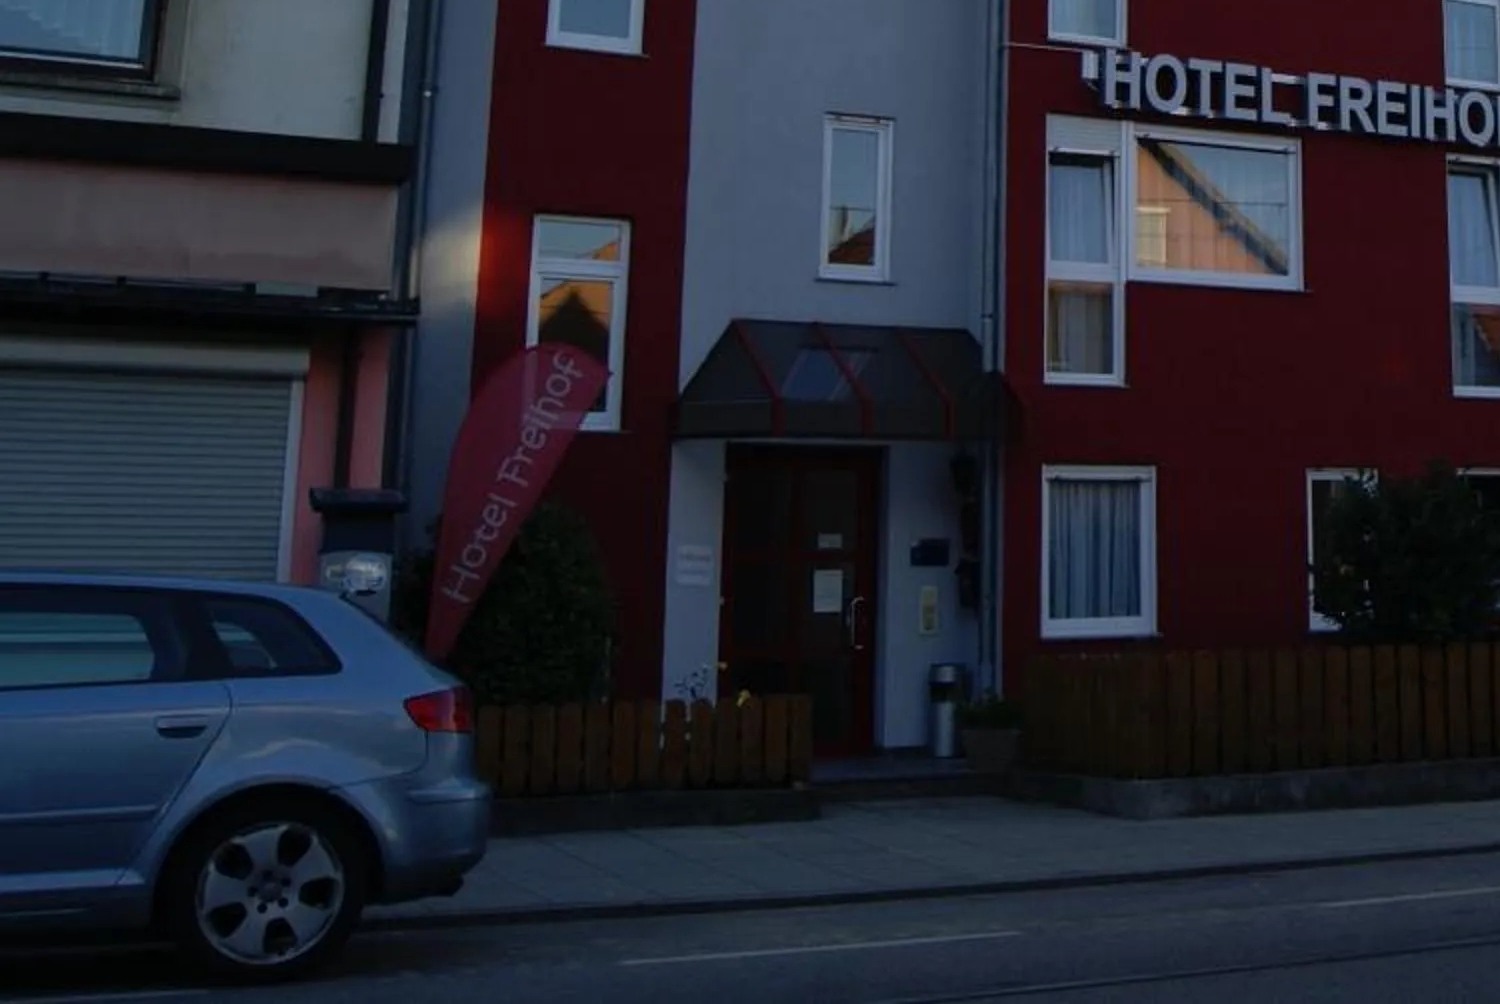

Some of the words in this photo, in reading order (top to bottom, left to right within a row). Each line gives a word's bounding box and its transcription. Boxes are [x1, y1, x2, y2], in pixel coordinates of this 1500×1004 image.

[1104, 48, 1294, 124] HOTEL
[441, 492, 519, 603] Hotel
[496, 350, 584, 488] Freihof
